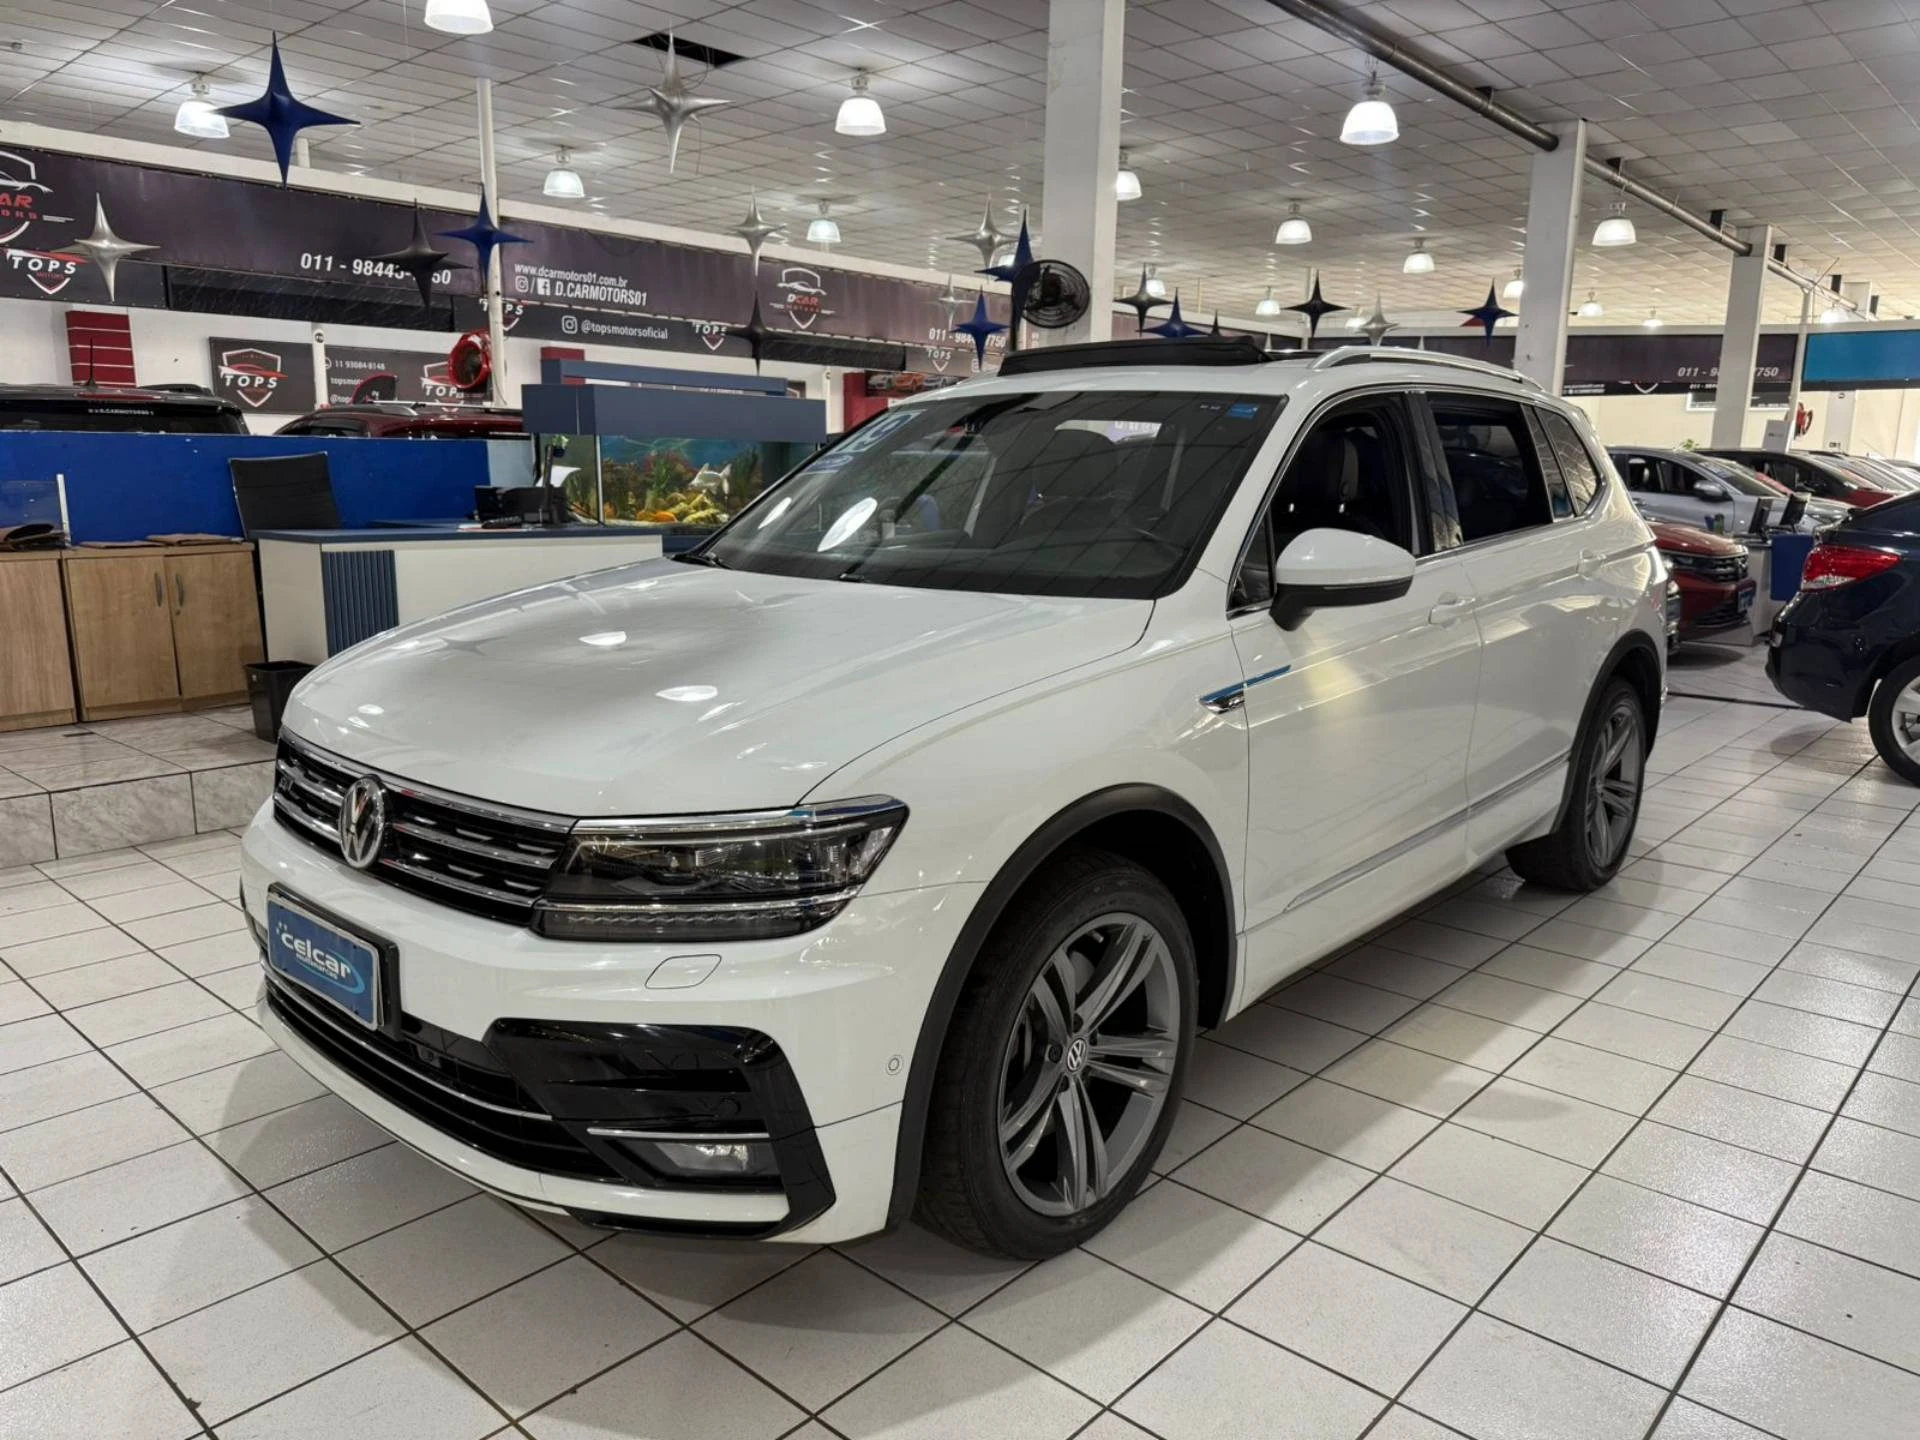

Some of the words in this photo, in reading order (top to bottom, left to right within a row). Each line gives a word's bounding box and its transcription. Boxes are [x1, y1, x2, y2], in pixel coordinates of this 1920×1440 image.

[12, 256, 77, 274] TOPS
[300, 252, 333, 272] 011
[514, 263, 628, 288] www.dcarmotors01.com.br
[555, 280, 648, 307] D.CARMOTORS01
[480, 299, 524, 316] TPS
[580, 319, 668, 340] @topsmotorsoficial
[1677, 366, 1699, 377] 011
[224, 375, 278, 389] TOPS
[425, 385, 457, 399] TOP
[281, 932, 351, 979] celcar
